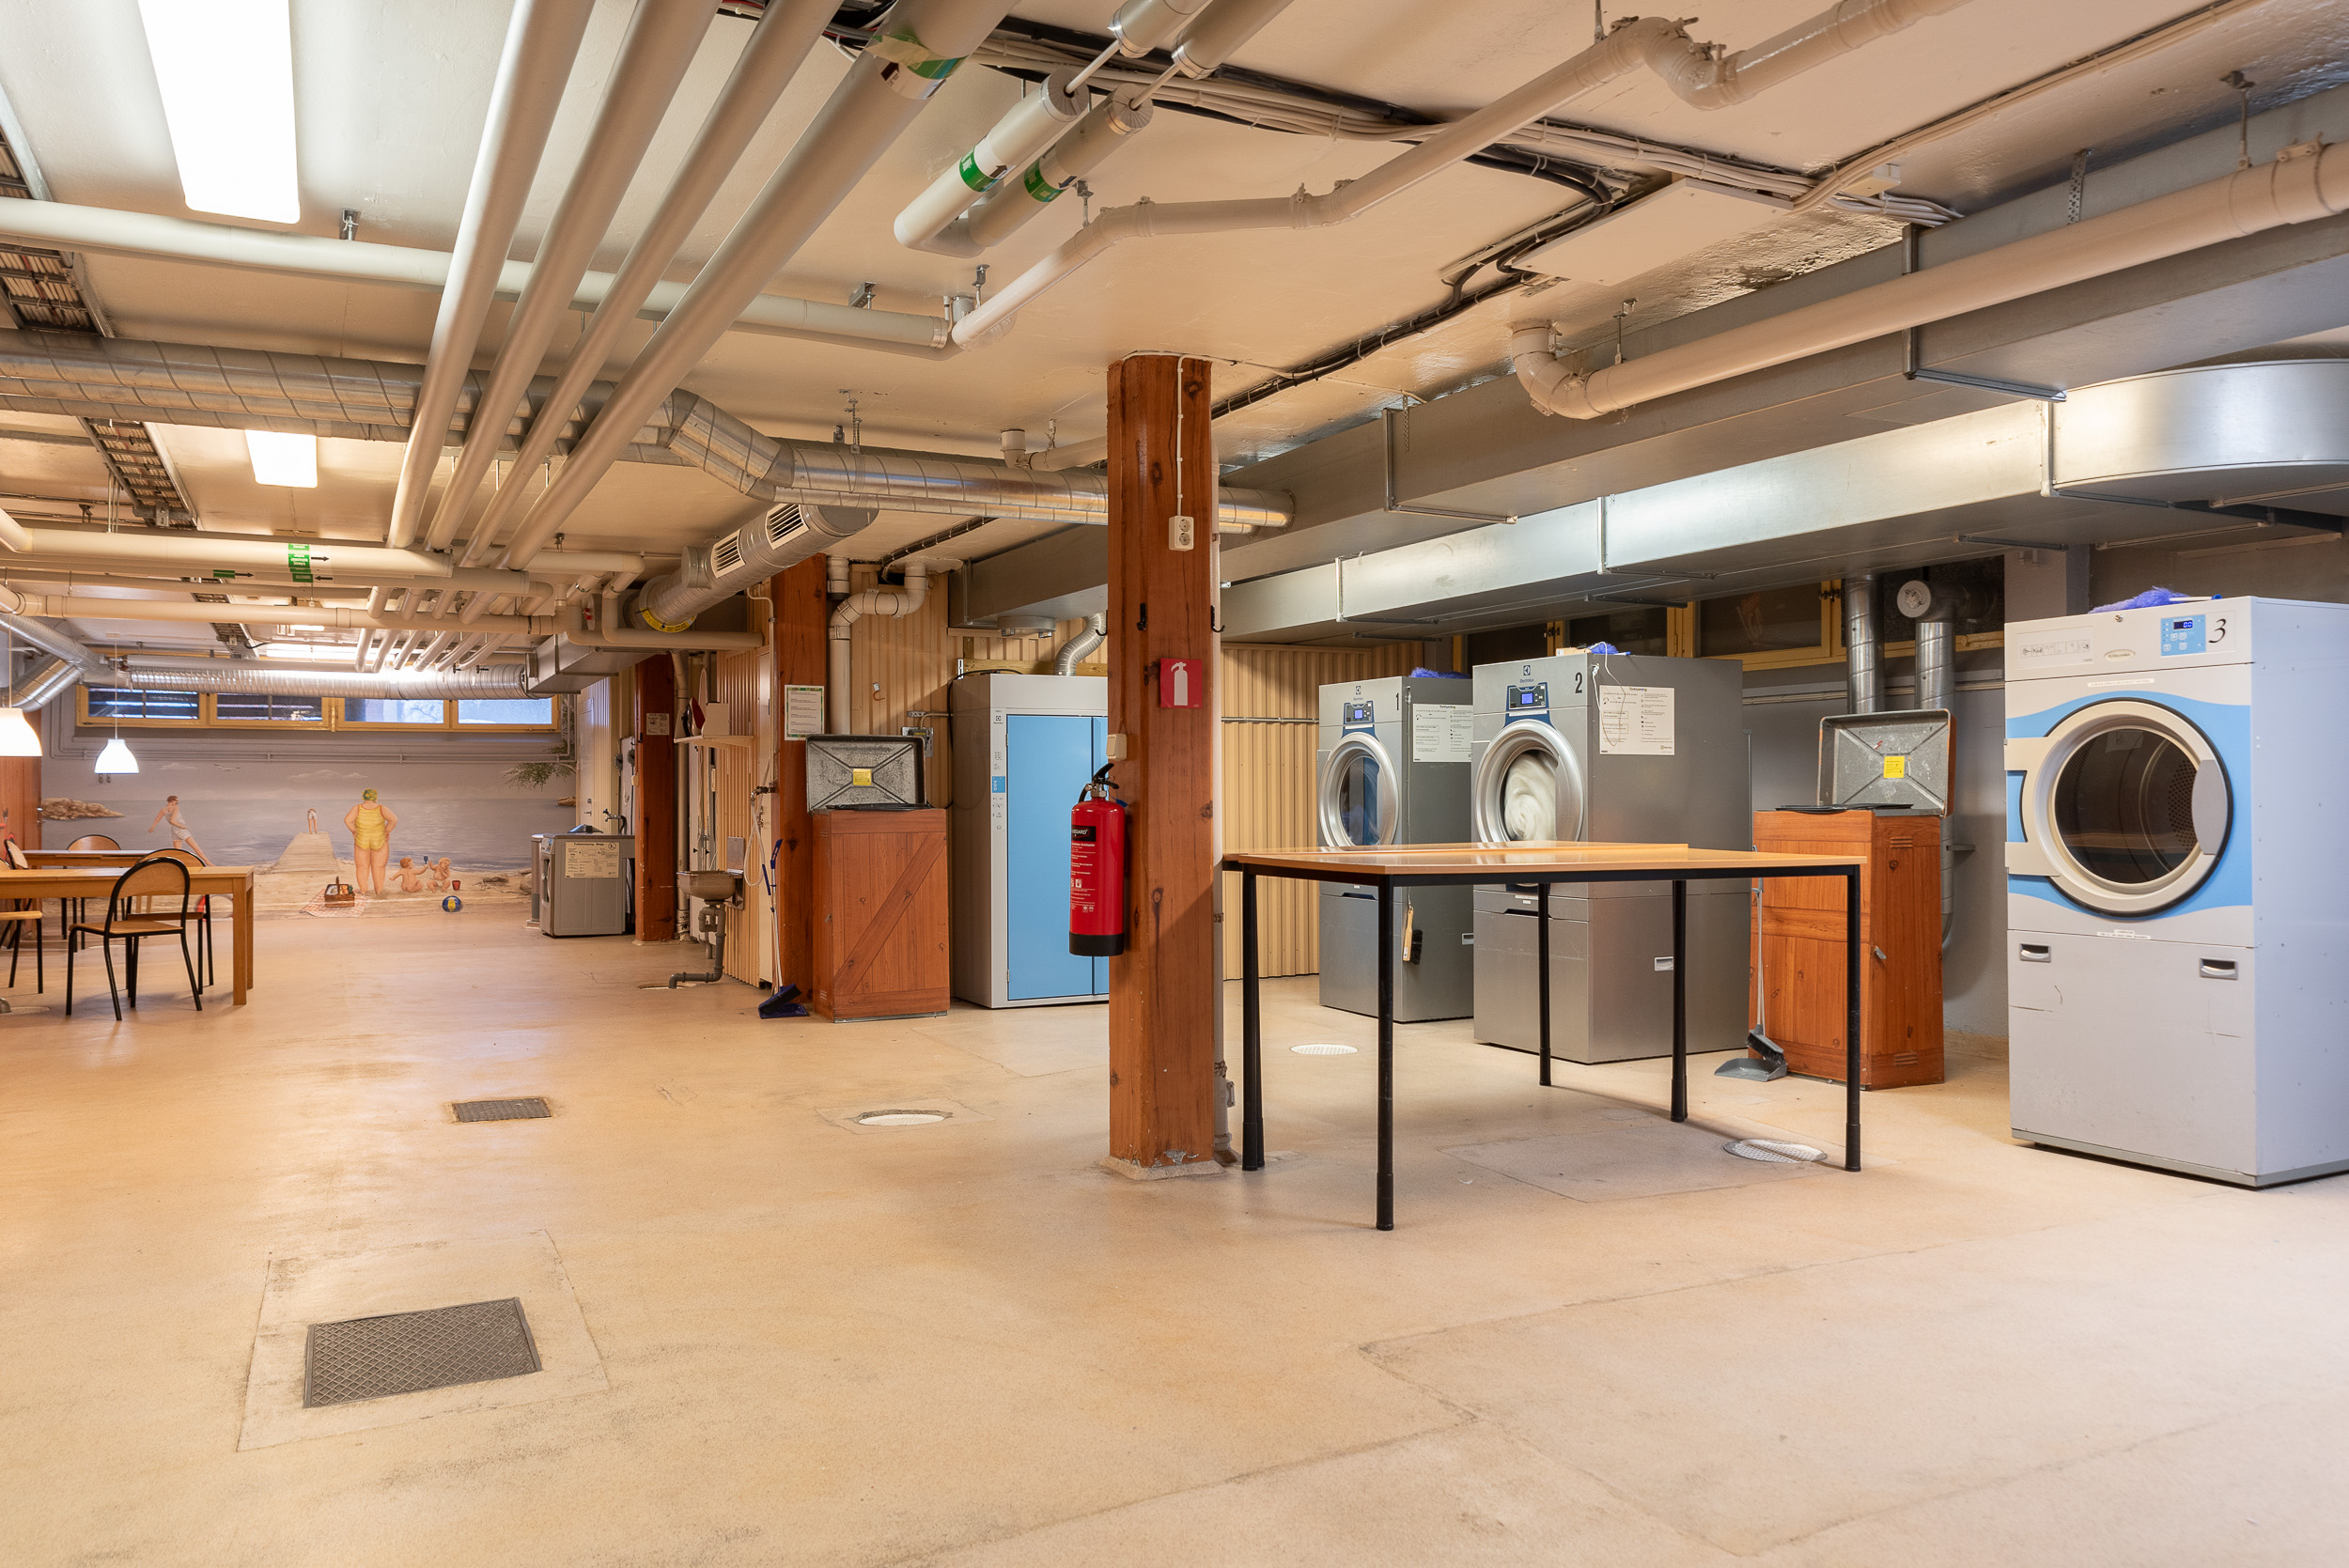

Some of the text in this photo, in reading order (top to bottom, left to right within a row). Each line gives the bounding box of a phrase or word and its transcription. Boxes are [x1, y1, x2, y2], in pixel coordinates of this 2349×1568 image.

[2208, 618, 2227, 644] 3
[1575, 673, 1582, 693] 2
[1395, 692, 1400, 711] 1
